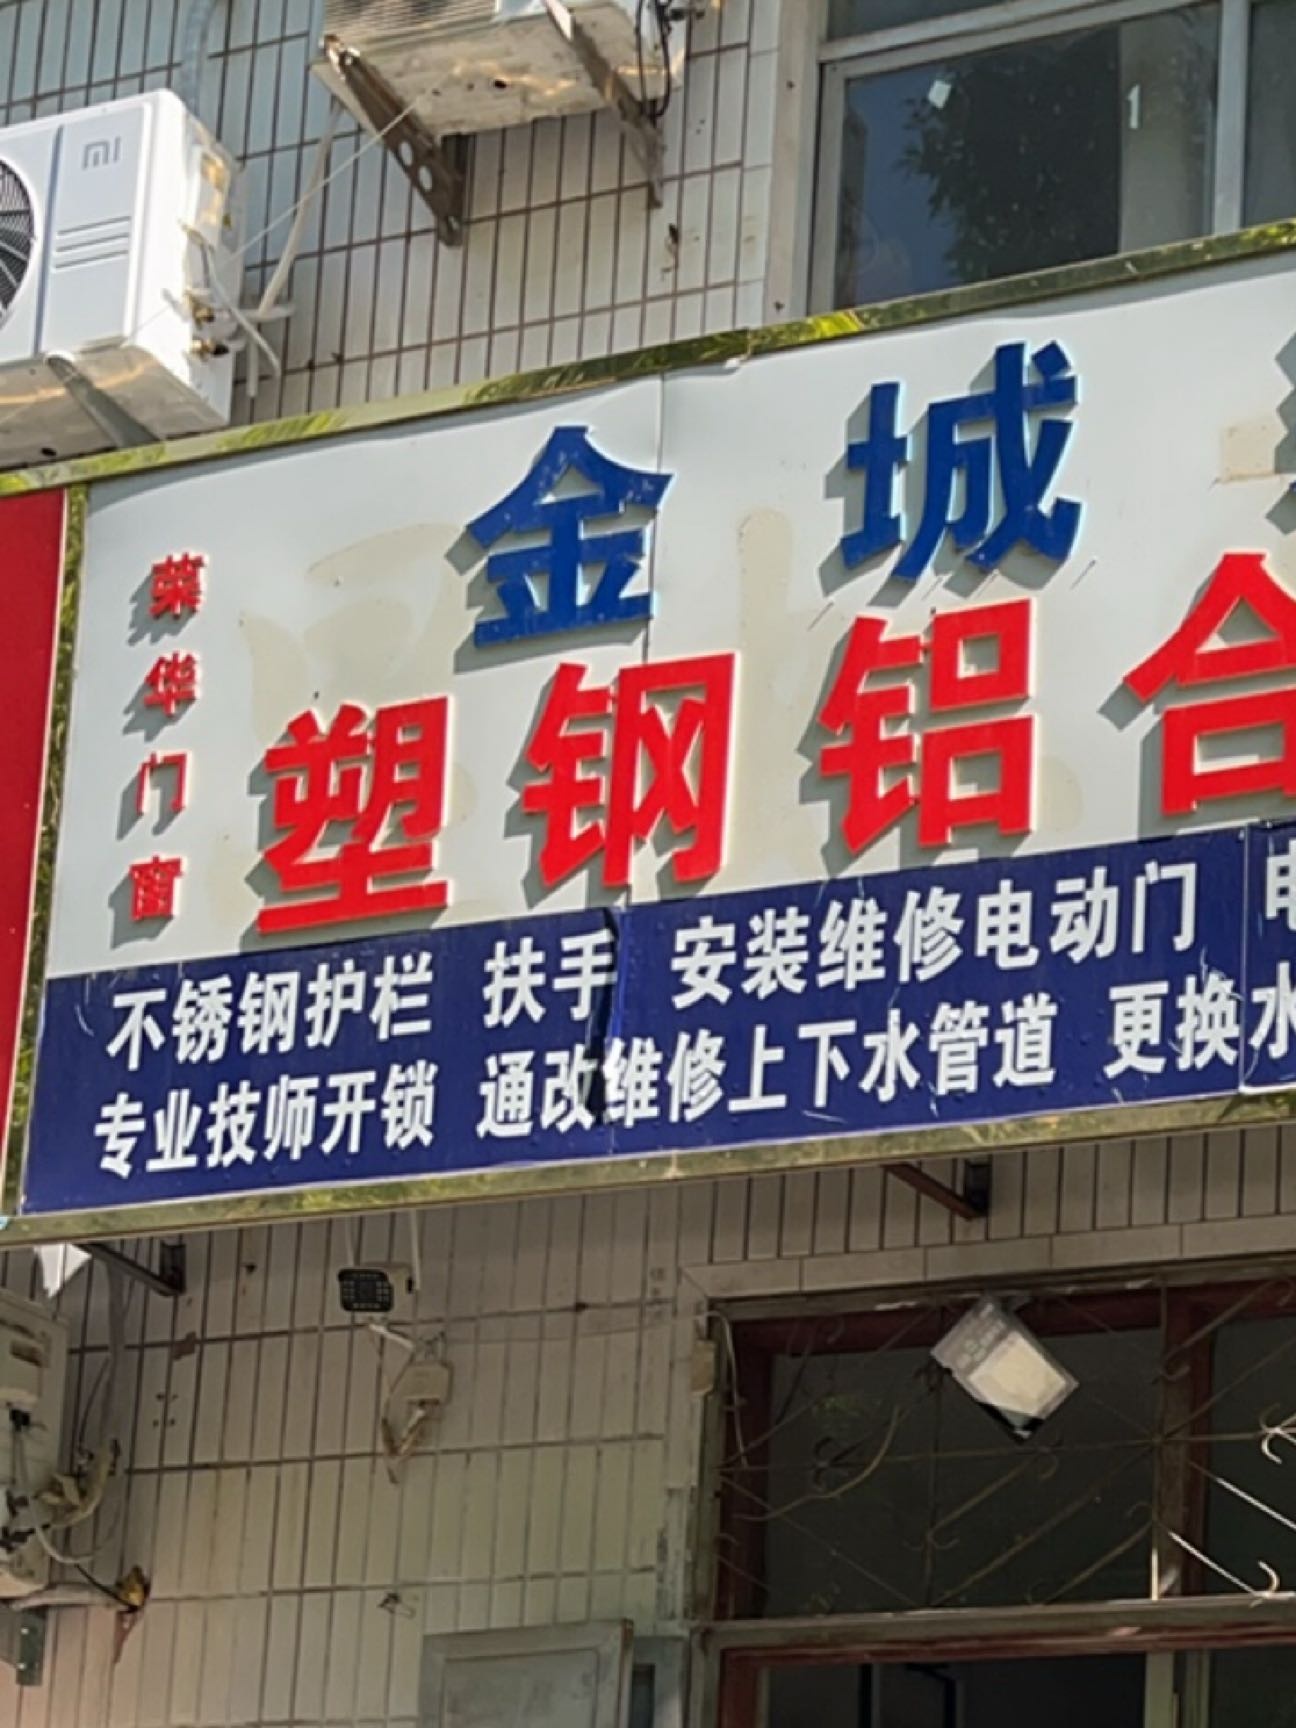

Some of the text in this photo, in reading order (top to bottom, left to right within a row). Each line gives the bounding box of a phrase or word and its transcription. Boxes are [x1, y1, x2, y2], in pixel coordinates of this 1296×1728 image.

[129, 552, 206, 921] 荣华门窗
[106, 950, 433, 1072] 不锈钢护栏
[482, 929, 618, 1028] 扶手
[670, 860, 1197, 1010] 安装维修电动门
[94, 1058, 438, 1179] 专业技师开锁
[476, 992, 1058, 1139] 通改维修上下水管道
